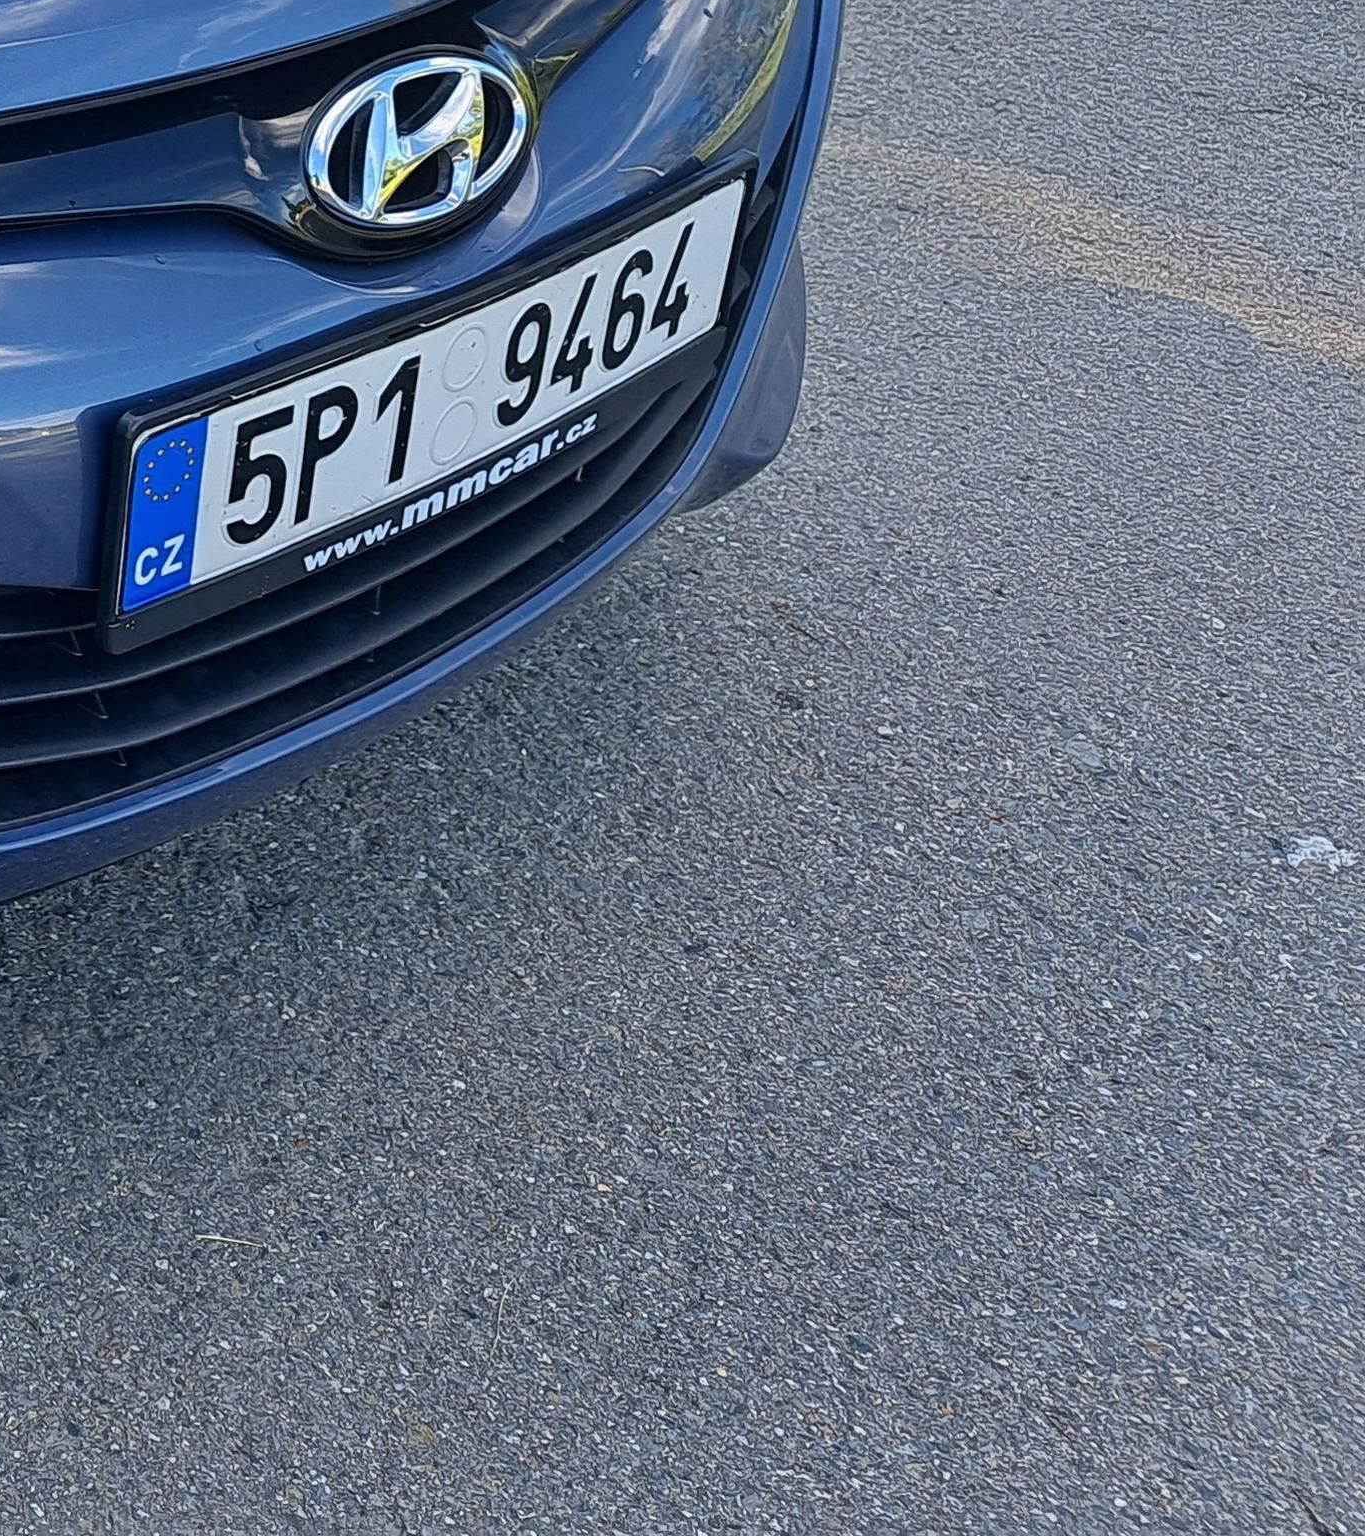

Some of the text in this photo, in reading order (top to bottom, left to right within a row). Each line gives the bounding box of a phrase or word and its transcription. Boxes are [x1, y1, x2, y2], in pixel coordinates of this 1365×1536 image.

[222, 221, 694, 546] 5P1 9464
[133, 533, 185, 587] CZ
[302, 410, 598, 573] www.mmcar.cz
